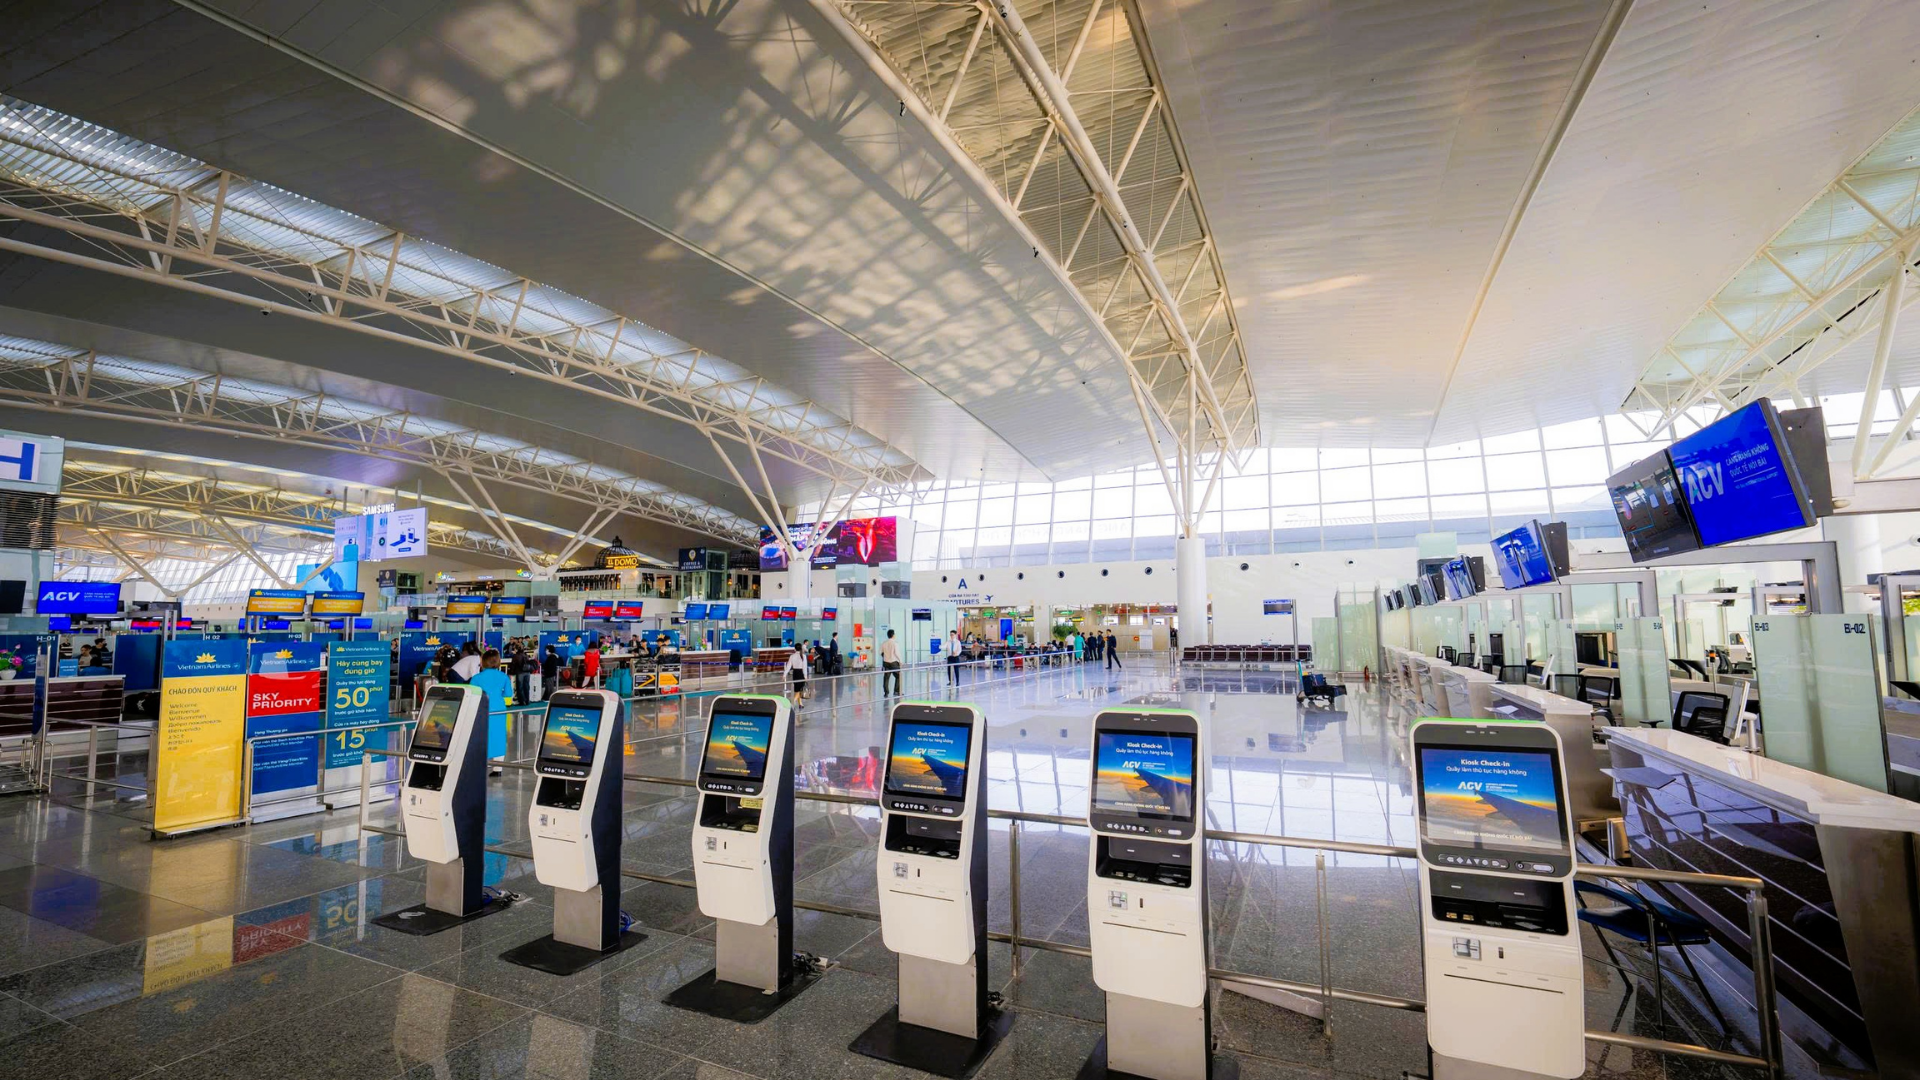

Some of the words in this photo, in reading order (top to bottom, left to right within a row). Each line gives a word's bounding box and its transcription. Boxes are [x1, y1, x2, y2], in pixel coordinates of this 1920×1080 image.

[1687, 461, 1724, 504] ACV
[362, 503, 395, 516] SAMSUNG
[958, 578, 967, 589] A
[42, 592, 80, 601] ACV
[1755, 623, 1769, 631] B-03
[1844, 623, 1865, 633] B-02
[253, 692, 279, 701] SKY
[334, 687, 369, 708] 50
[252, 698, 312, 709] PRIORITY
[336, 729, 365, 750] 15
[1458, 781, 1482, 790] ACV
